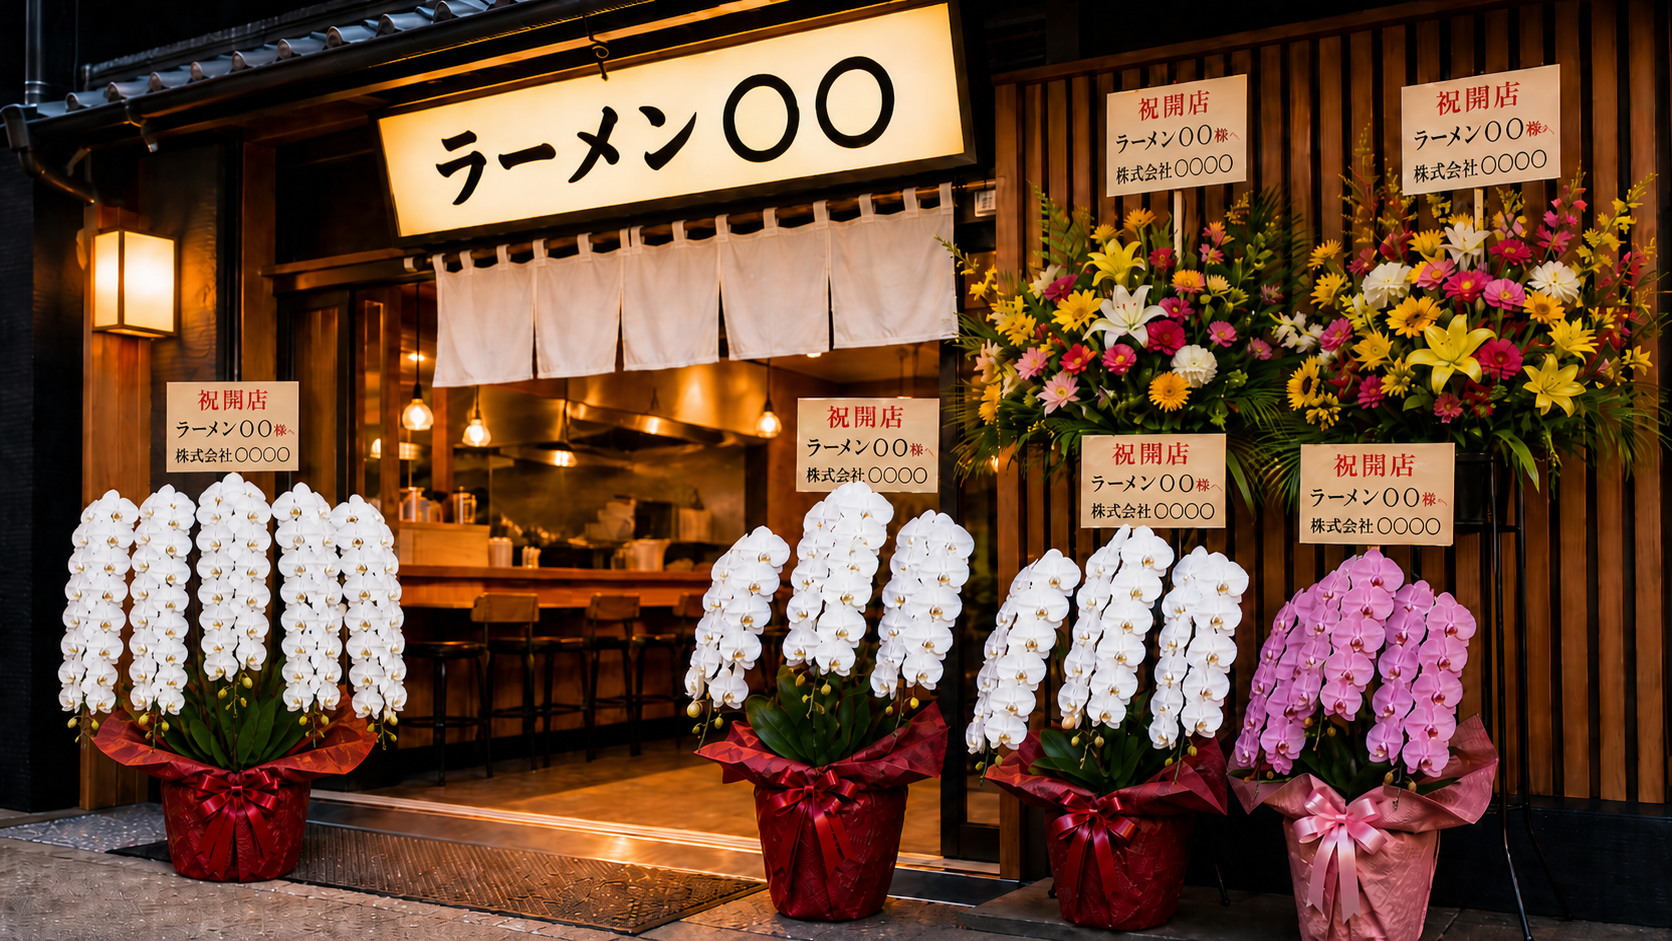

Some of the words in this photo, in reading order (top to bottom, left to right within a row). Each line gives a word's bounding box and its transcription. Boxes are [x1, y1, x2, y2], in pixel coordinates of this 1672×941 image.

[1138, 89, 1210, 121] 祝開店
[1436, 81, 1521, 116] 祝開店
[197, 389, 268, 411] 祝開店
[826, 405, 904, 429] 祝開店
[1112, 441, 1189, 466] 祝開店
[1333, 453, 1416, 478] 祝開店
